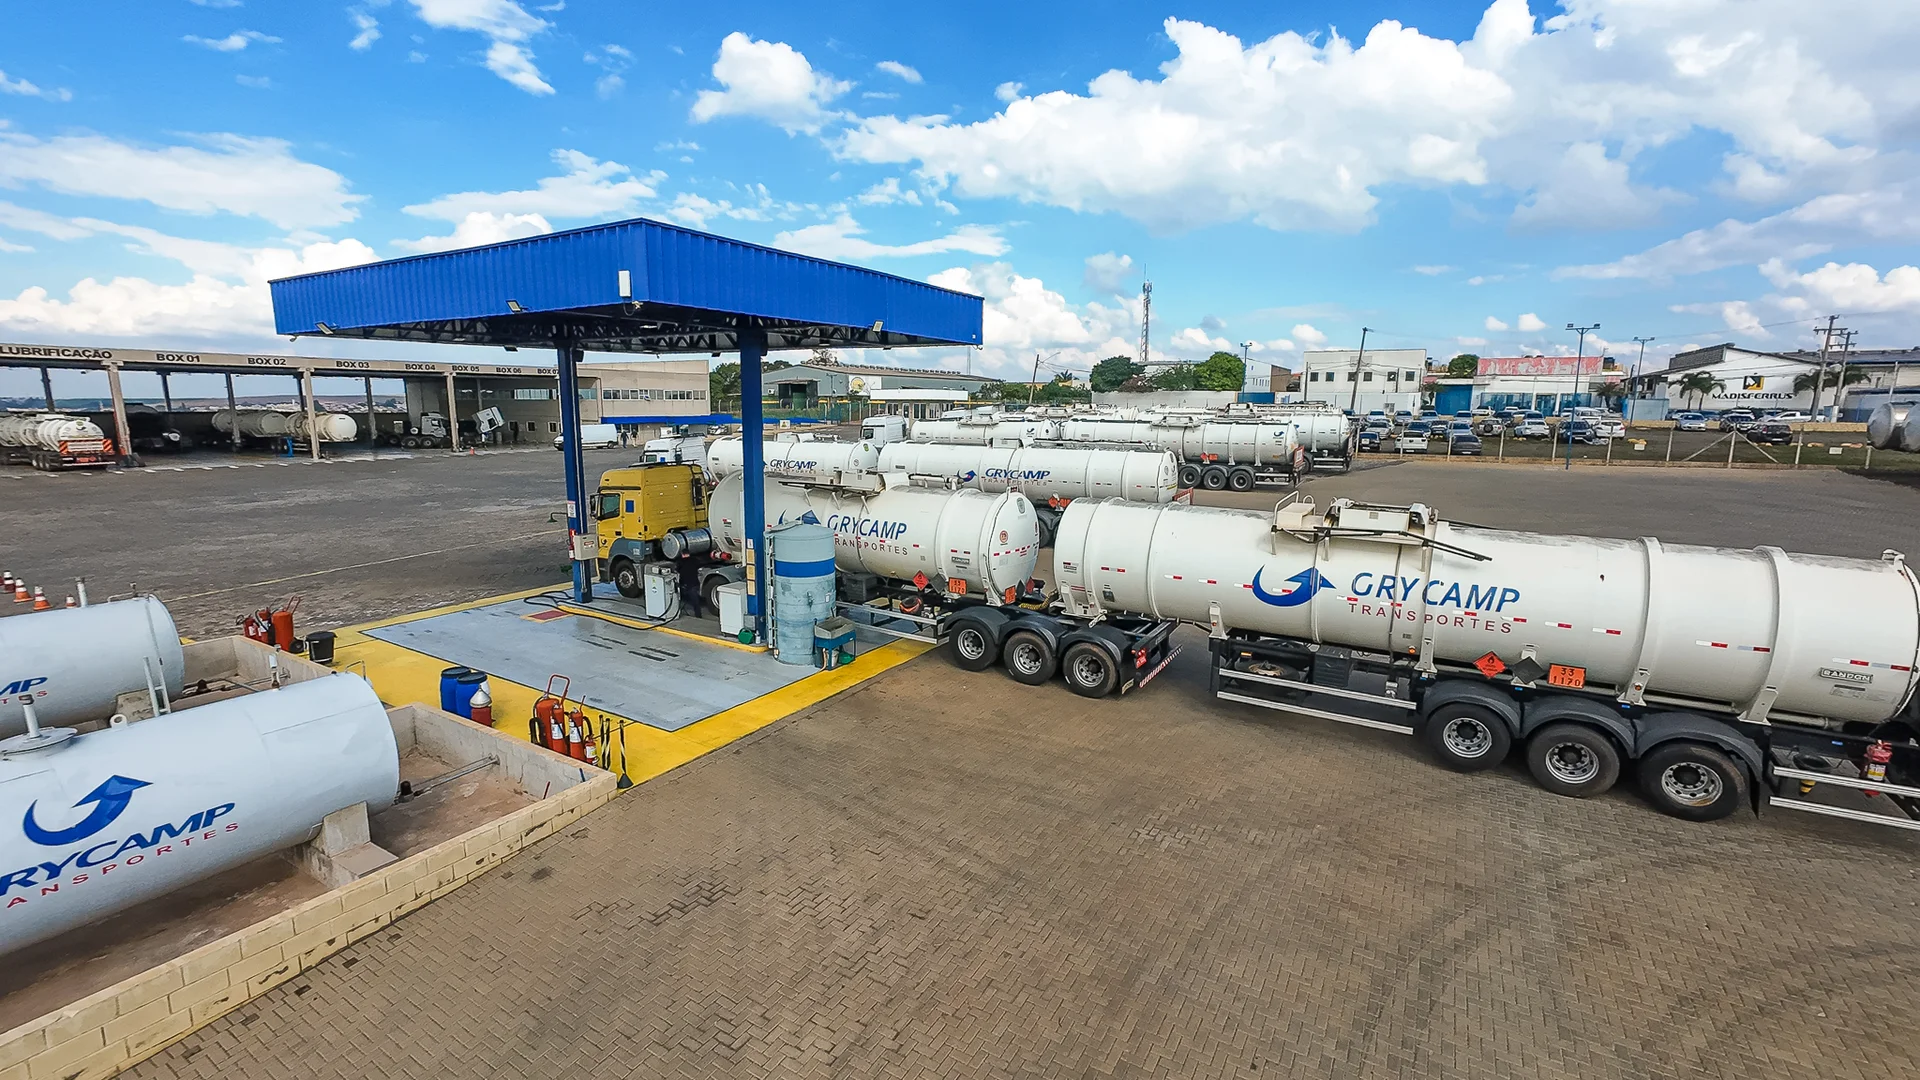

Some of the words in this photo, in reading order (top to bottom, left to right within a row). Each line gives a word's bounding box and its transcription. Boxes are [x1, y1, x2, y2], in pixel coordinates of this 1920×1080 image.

[0, 346, 112, 359] LUBRIFICAÇÃO
[156, 353, 184, 362] BOX
[186, 355, 200, 363] 01
[248, 357, 272, 365] BOX
[336, 360, 357, 368] BOX
[358, 361, 370, 369] 03
[770, 459, 817, 470] GRYCAMP
[985, 468, 1050, 479] GRYCAMP
[827, 514, 907, 540] GRYCAMP
[834, 537, 908, 555] RANSPORTES
[1351, 572, 1520, 612] GRYCAMP
[1349, 603, 1512, 633] TRANSPORTES
[1560, 667, 1575, 677] 33
[1822, 670, 1871, 681] RANDON
[1552, 676, 1581, 686] 1170
